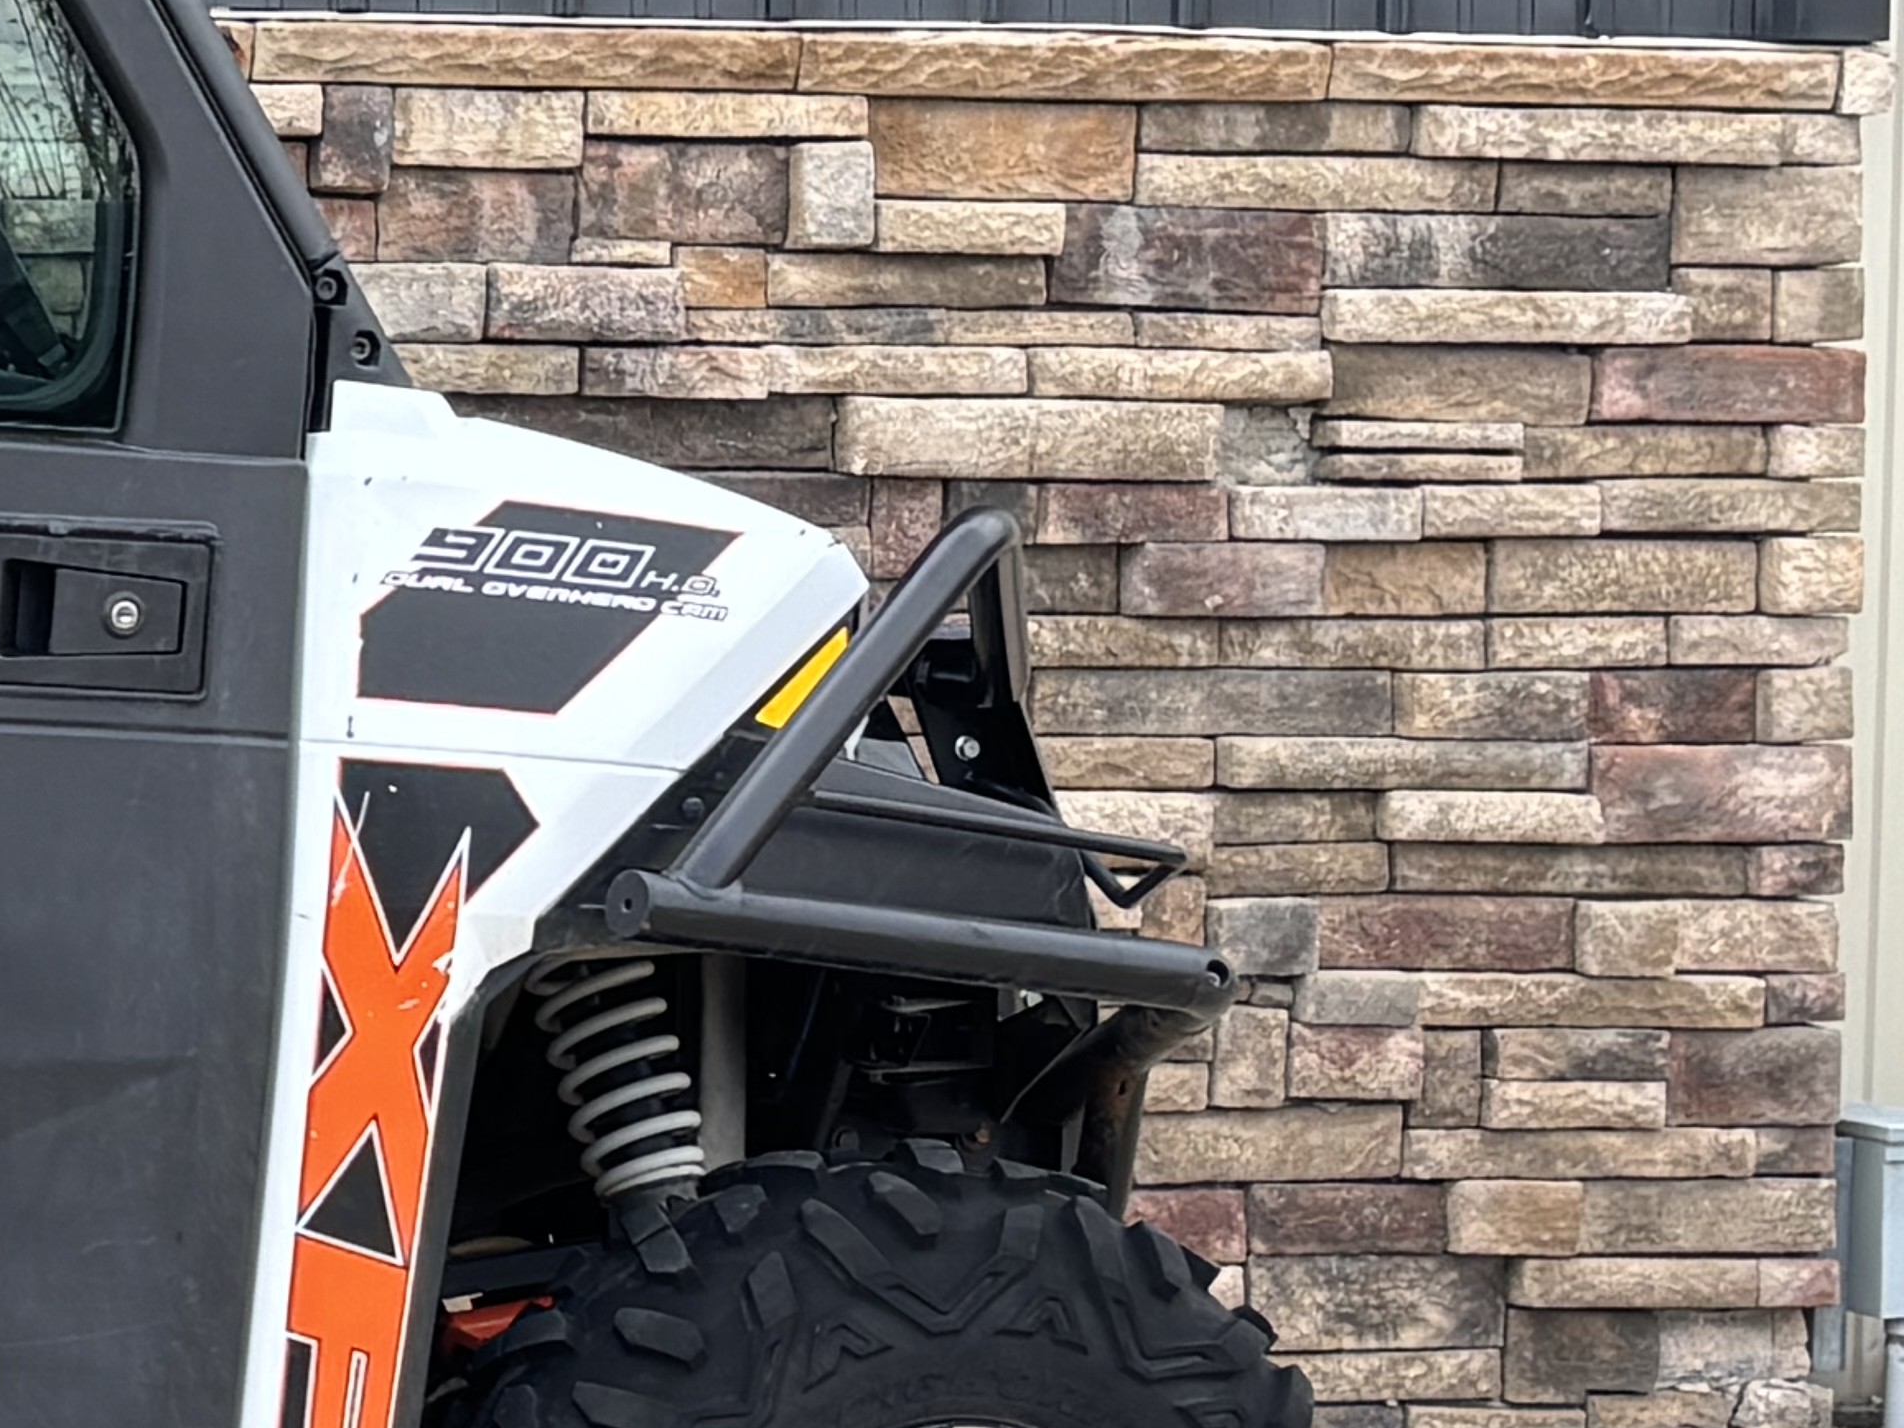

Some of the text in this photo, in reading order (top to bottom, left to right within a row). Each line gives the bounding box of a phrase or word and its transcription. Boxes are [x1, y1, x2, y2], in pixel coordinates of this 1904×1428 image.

[380, 570, 729, 622] DUAL OVERHEAD CAM
